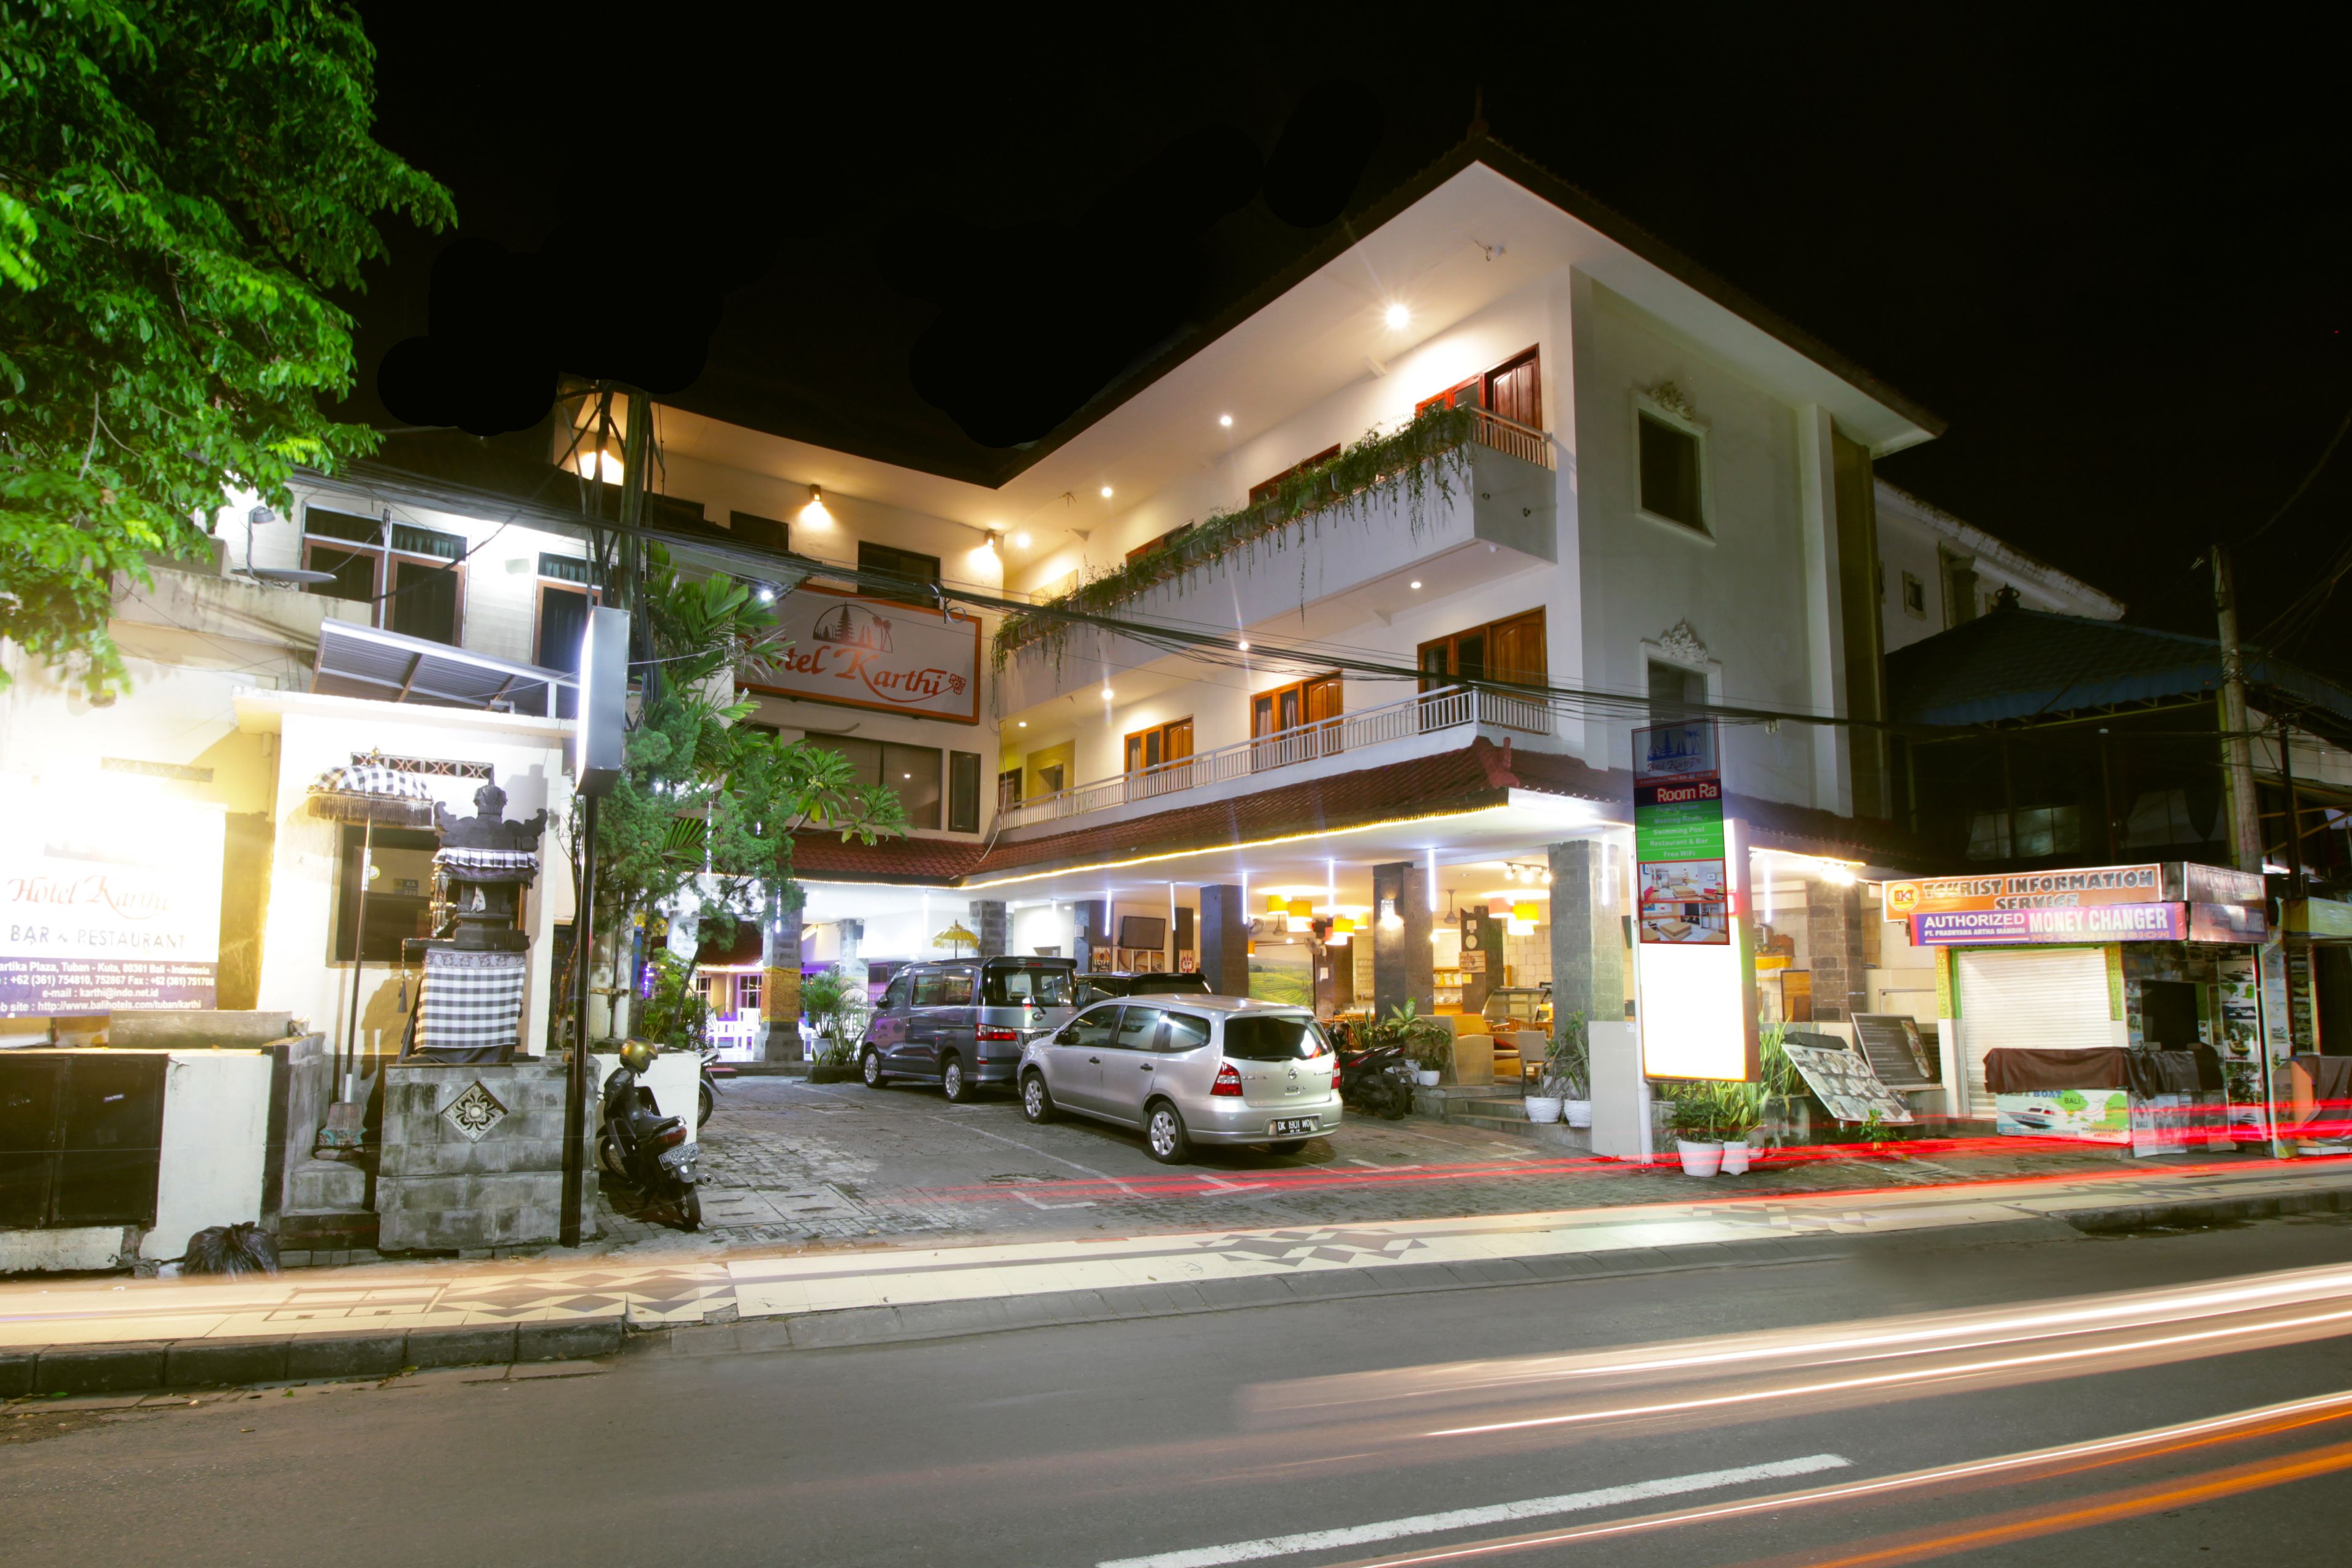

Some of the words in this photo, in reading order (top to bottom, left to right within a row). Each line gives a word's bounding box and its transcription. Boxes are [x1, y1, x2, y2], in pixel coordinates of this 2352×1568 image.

[833, 648, 953, 703] Karthi
[1647, 763, 1665, 772] Hotel
[1657, 788, 1695, 802] Room
[1699, 783, 1717, 797] Ra
[7, 877, 78, 904] Hotel
[1923, 878, 2003, 899] TOURIST
[2005, 869, 2155, 895] INFORMATION
[1994, 894, 2079, 911] SERVICE
[1924, 913, 2025, 928] AUTHORIZED
[2029, 911, 2084, 933] MONEY
[2089, 908, 2168, 932] CHANGER
[10, 925, 49, 943] BAR
[78, 929, 186, 949] RESTAURANT
[2058, 930, 2170, 941] COMMISSION
[29, 962, 59, 973] Plaza,
[61, 962, 89, 972] Tuban
[97, 963, 120, 973] Kuta,
[123, 963, 147, 973] 80361
[149, 965, 165, 973] Bali
[172, 965, 210, 975] Indonesia
[1937, 952, 1946, 974] TOUR
[2108, 948, 2119, 976] BOOK
[10, 975, 29, 985] +62
[31, 975, 56, 987] (361)
[95, 975, 126, 985] 752867
[128, 976, 143, 985] Fax
[151, 976, 165, 986] +62
[167, 976, 186, 988] (361)
[187, 977, 215, 987] 751708
[42, 988, 72, 997] e-mail
[80, 987, 159, 1000] karthi@indo.net.id
[10, 1002, 29, 1011] site
[38, 1000, 202, 1012] http://www.balihotels.com/tuban/karthi
[1278, 1121, 1286, 1130] DK
[1289, 1120, 1300, 1129] 1901
